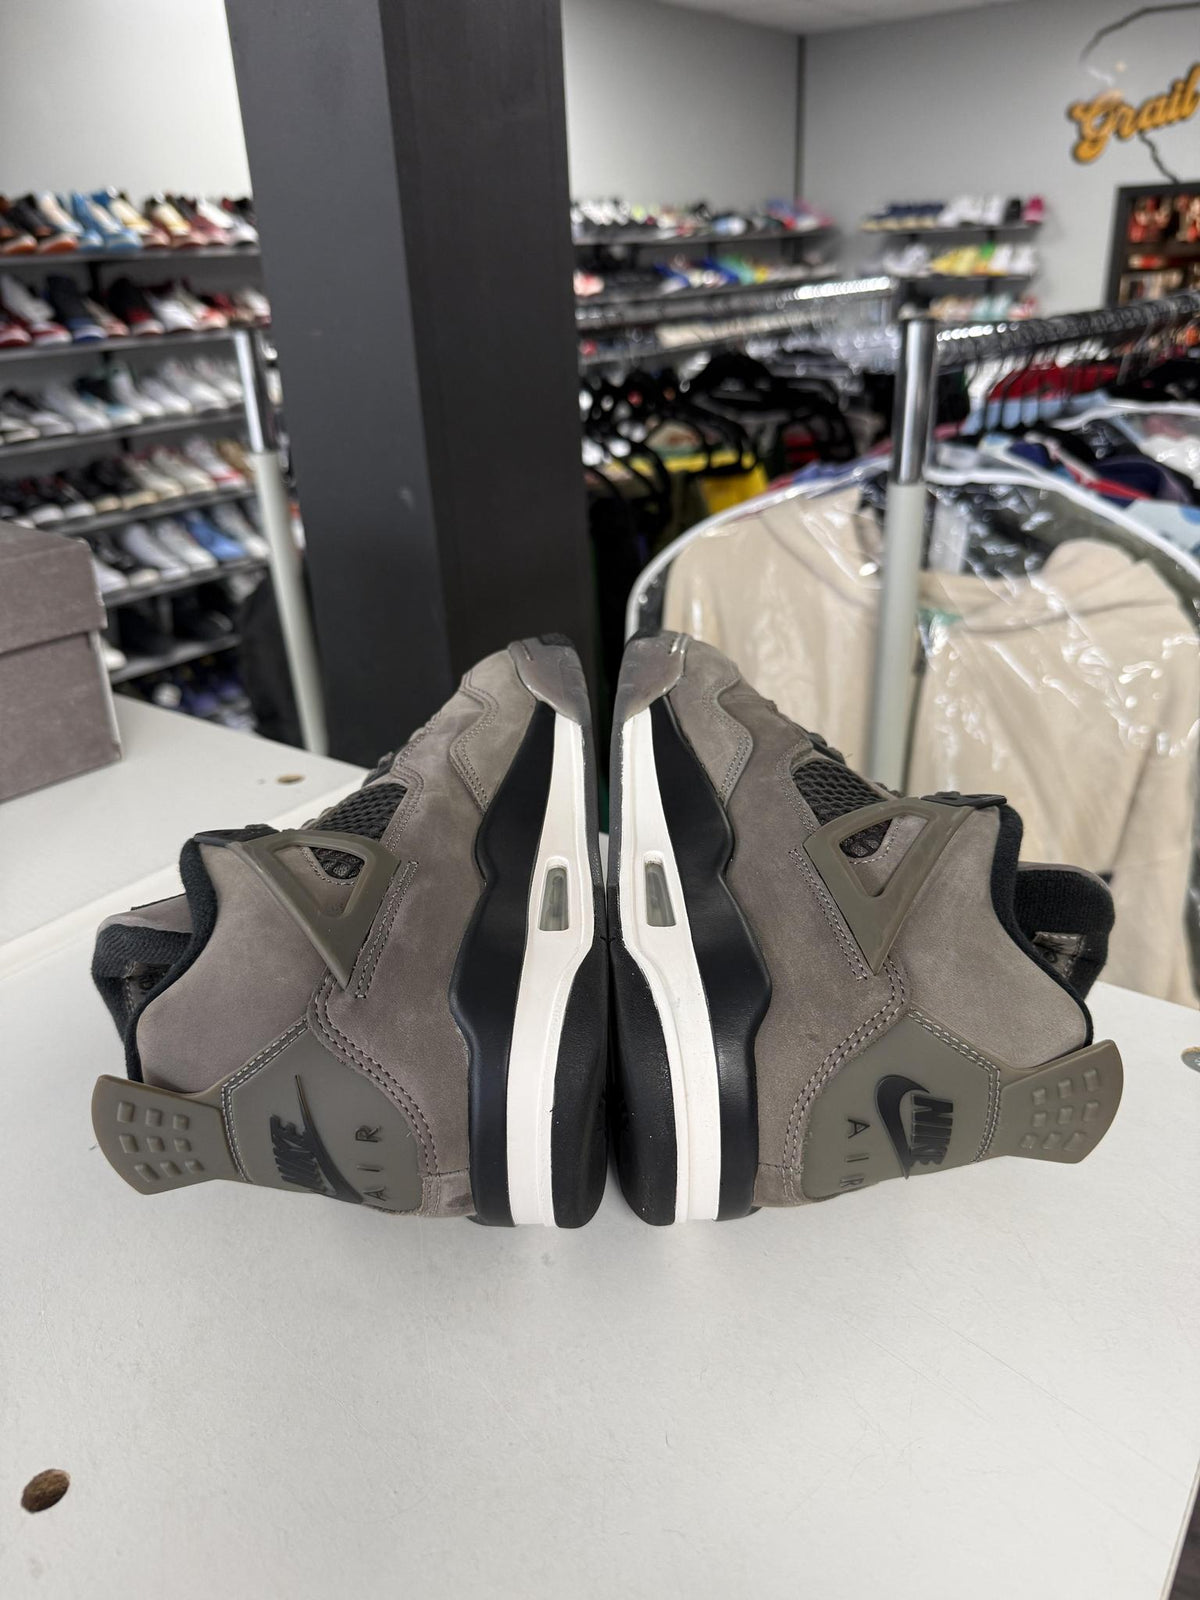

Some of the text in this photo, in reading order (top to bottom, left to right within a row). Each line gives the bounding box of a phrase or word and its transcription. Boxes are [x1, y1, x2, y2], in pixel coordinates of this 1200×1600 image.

[270, 1114, 328, 1193] NIKE
[355, 1124, 386, 1202] AIR
[839, 1118, 871, 1188] AIR
[912, 1094, 954, 1167] NIKE
